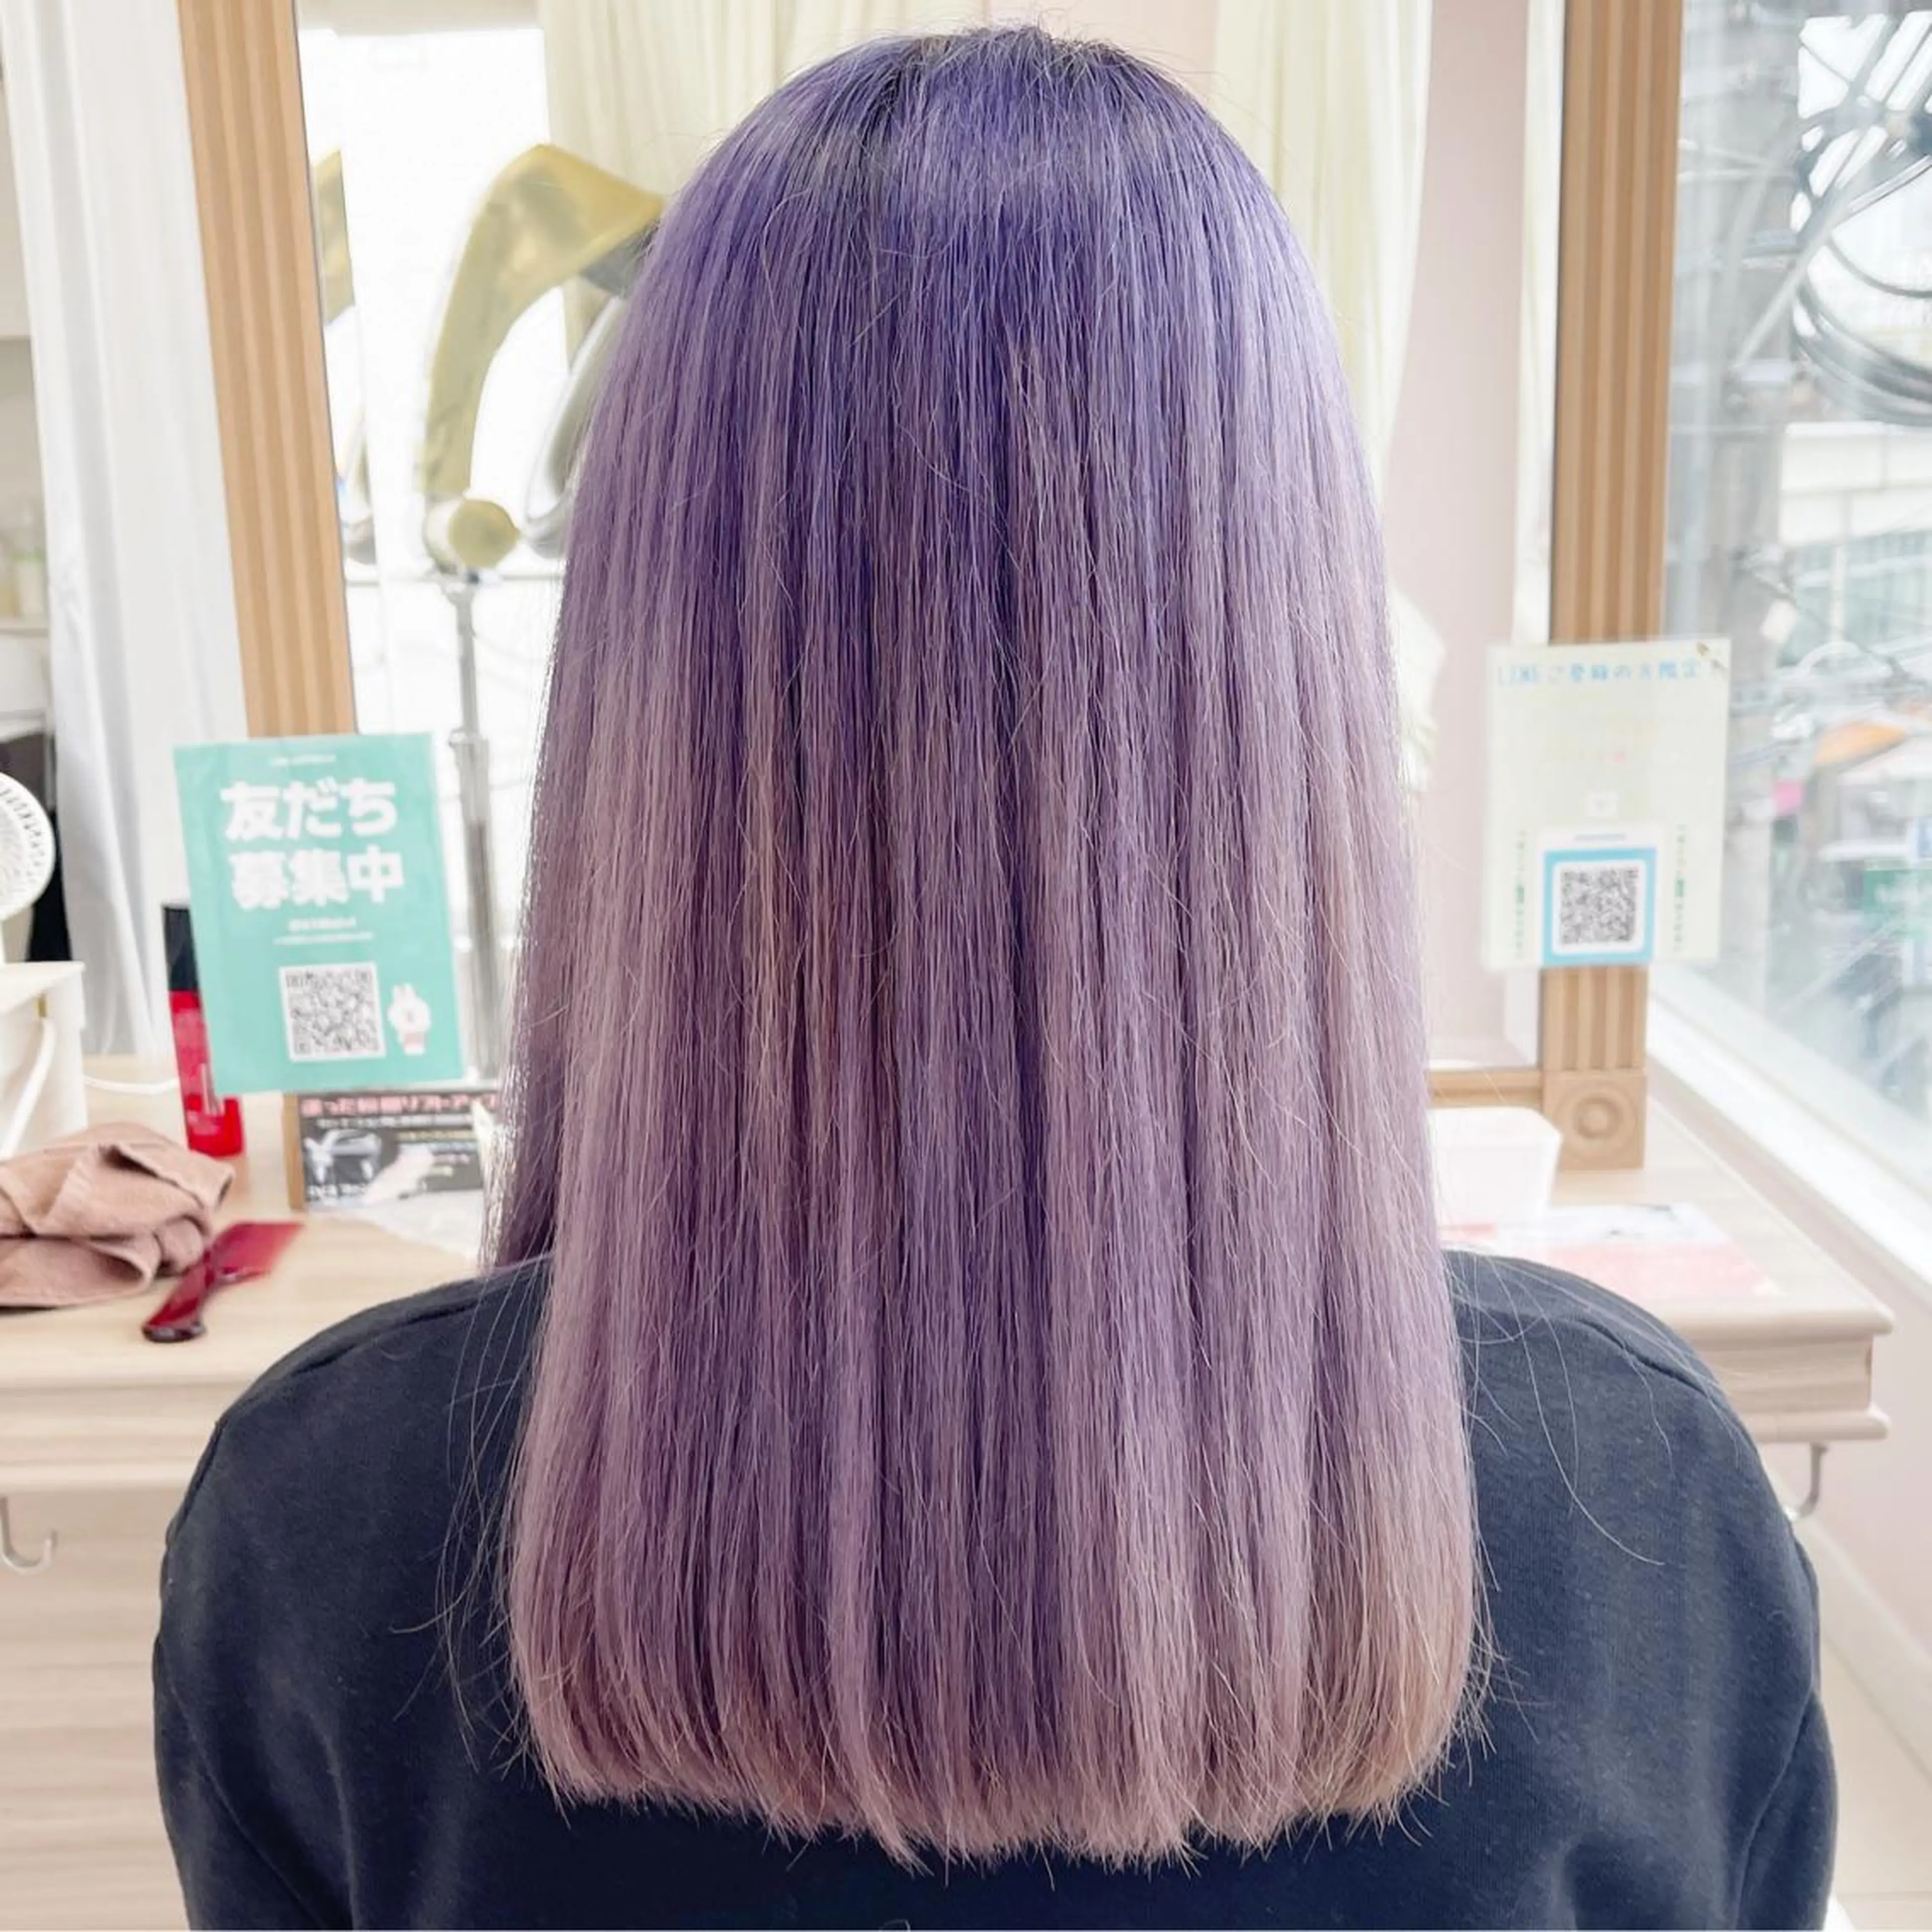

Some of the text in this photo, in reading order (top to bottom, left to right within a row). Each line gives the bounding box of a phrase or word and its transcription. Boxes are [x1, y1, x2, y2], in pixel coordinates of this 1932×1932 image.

[220, 777, 396, 840] 友だち
[228, 844, 404, 910] 募集中
